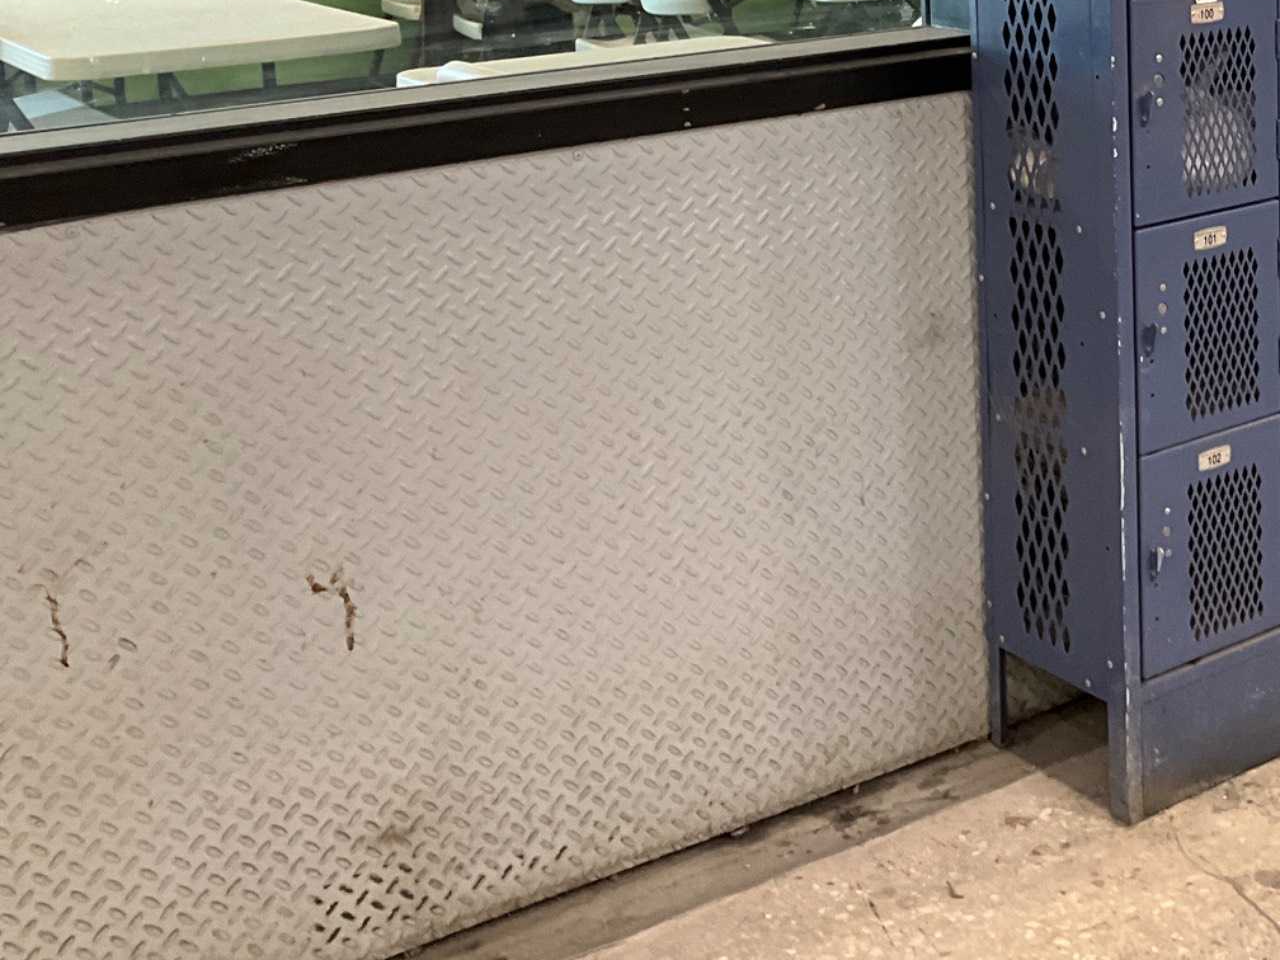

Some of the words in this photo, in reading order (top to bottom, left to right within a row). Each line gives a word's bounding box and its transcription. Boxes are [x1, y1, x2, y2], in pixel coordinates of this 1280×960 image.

[1200, 8, 1214, 20] 100
[1204, 233, 1217, 245] 101
[1208, 453, 1221, 465] 102
